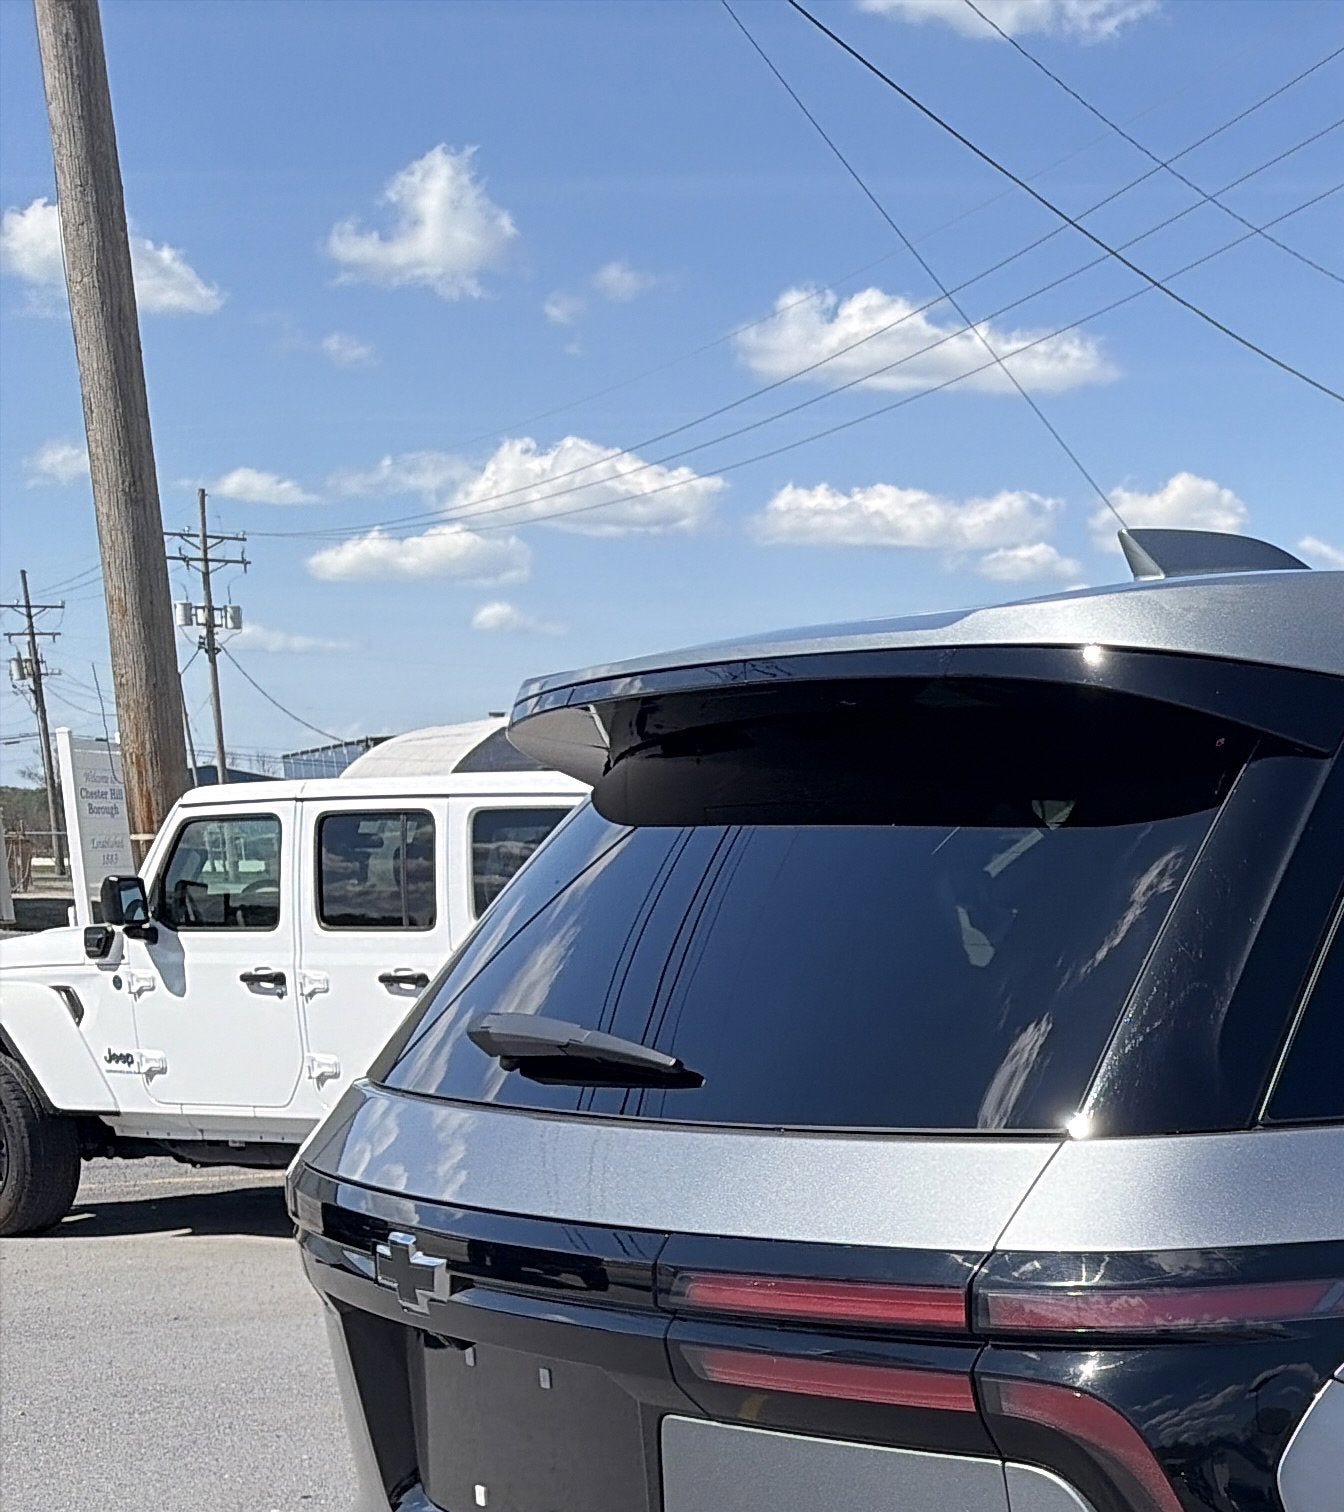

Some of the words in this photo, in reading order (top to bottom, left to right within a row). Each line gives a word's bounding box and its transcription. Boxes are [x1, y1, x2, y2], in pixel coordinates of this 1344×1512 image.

[80, 787, 109, 800] Chester
[110, 788, 124, 801] Hill
[88, 802, 120, 818] Borough
[104, 1047, 135, 1068] Jeep
